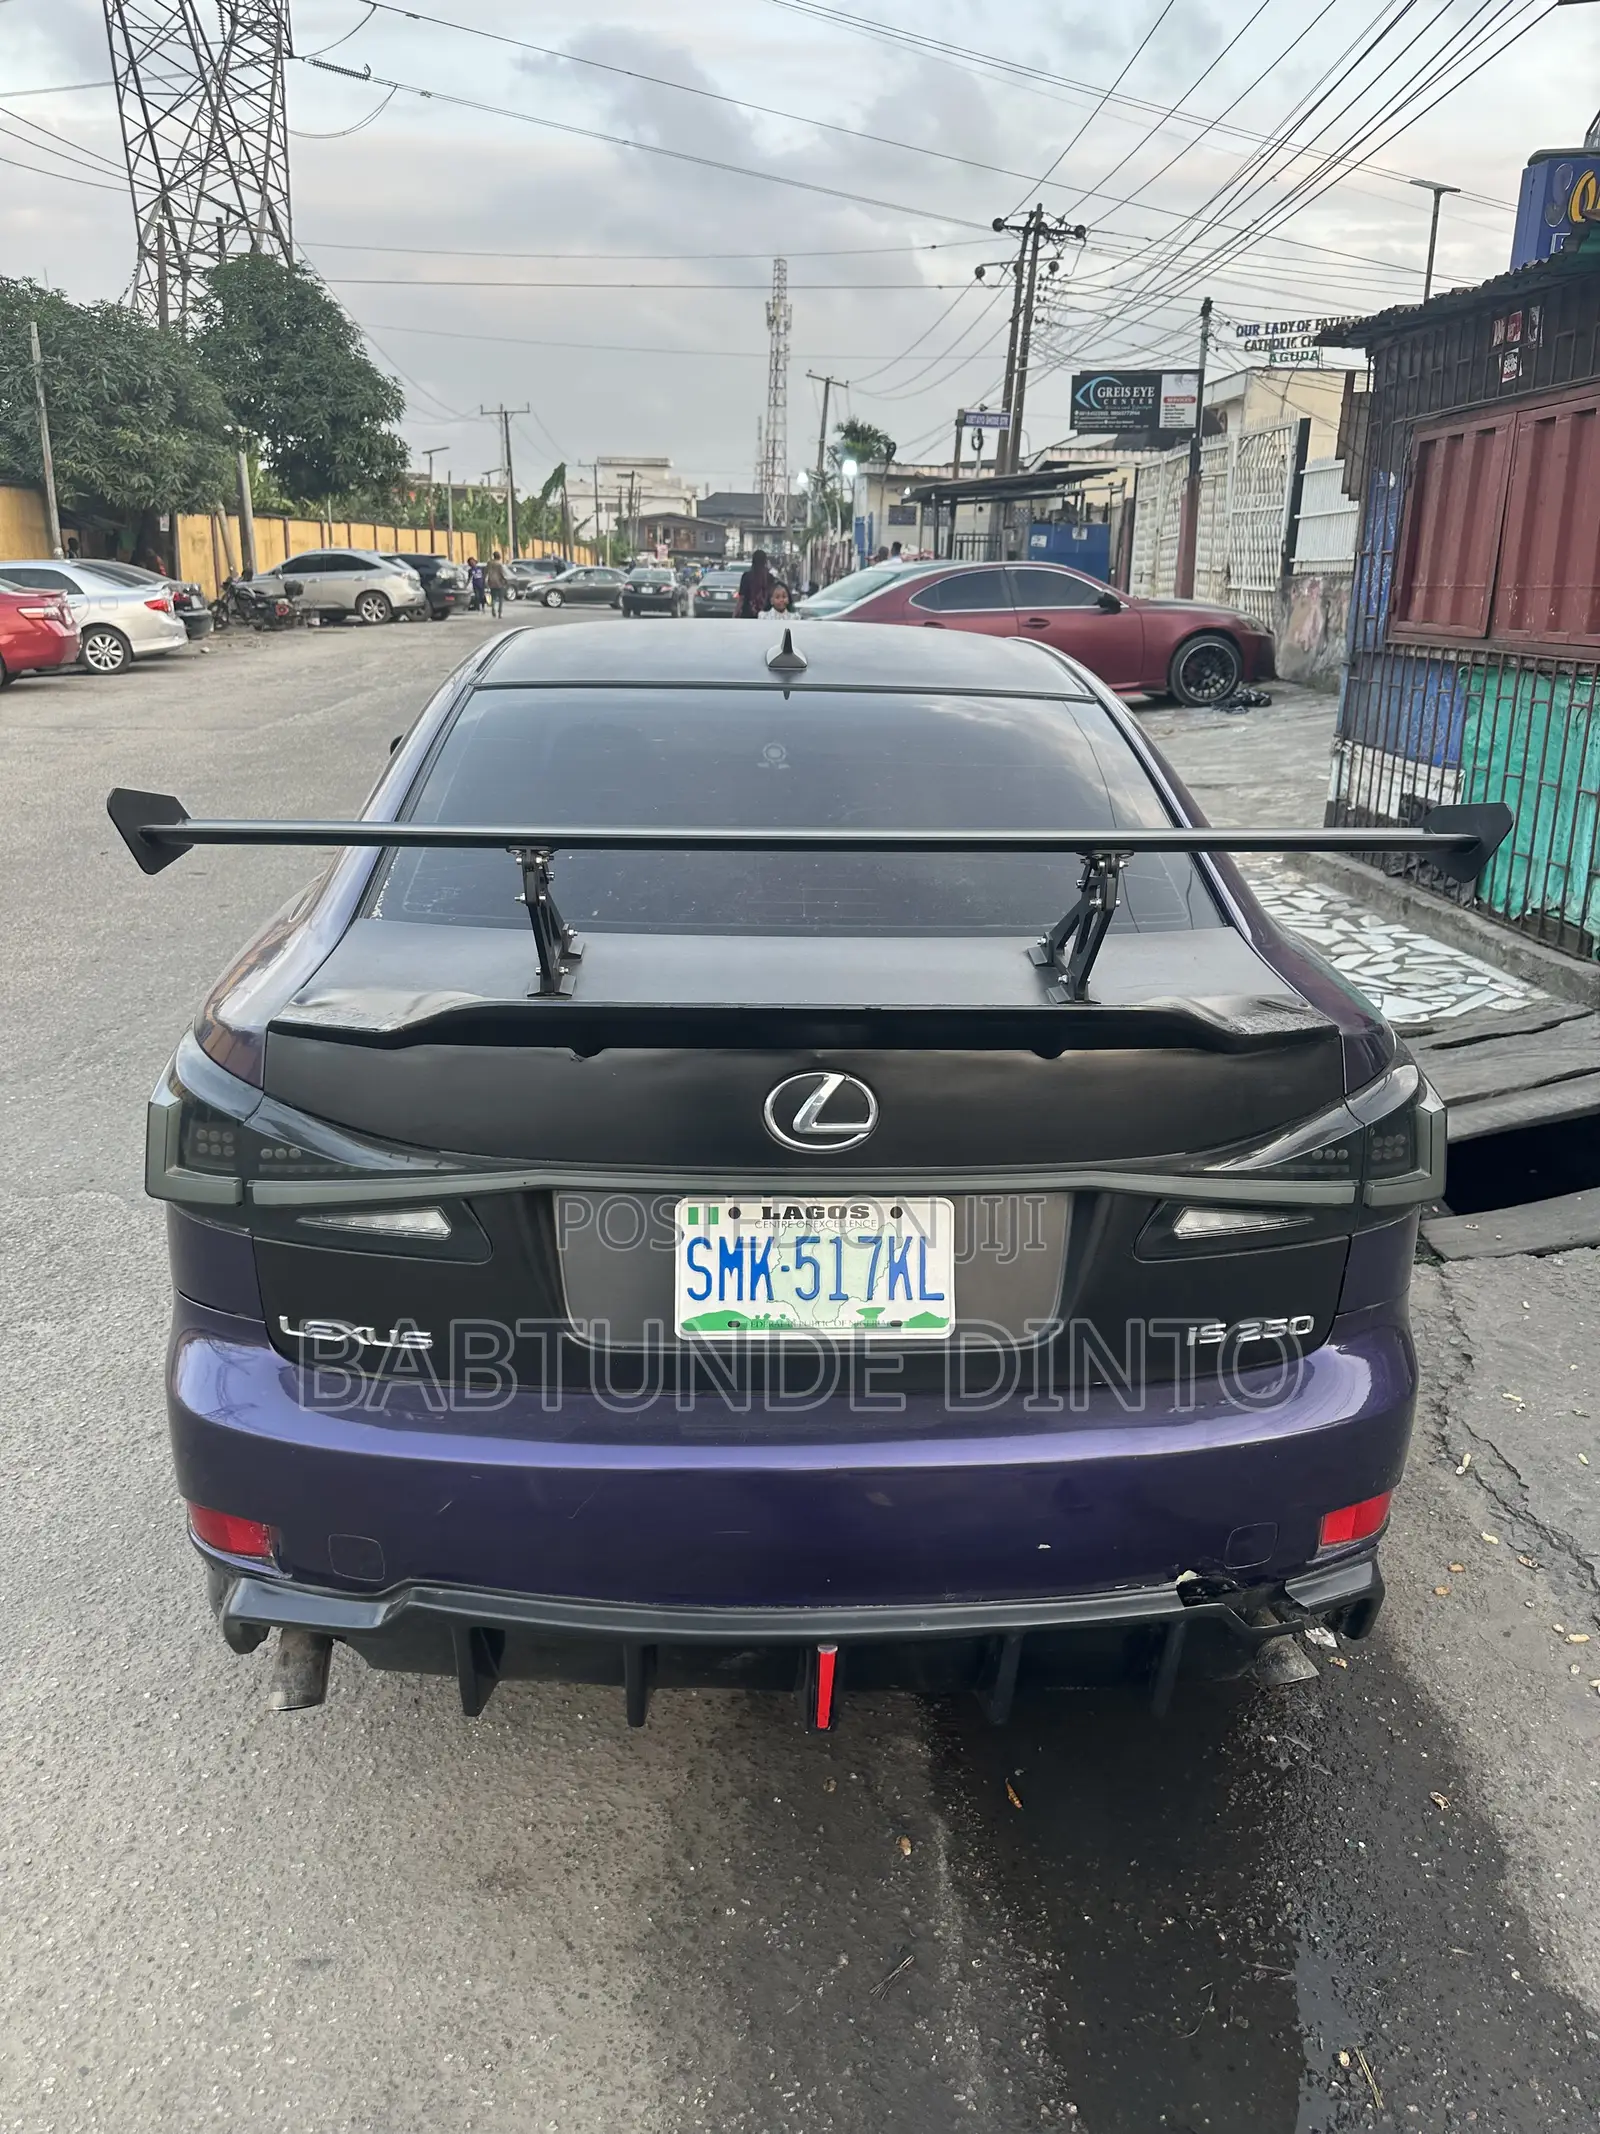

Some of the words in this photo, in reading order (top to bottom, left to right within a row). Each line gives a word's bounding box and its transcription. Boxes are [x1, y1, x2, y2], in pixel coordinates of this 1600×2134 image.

[1236, 324, 1260, 337] OUR
[1265, 321, 1296, 335] LADY
[1297, 319, 1312, 332] OF
[1244, 338, 1298, 352] CATHOLIC
[1269, 350, 1319, 362] AGUDA
[1097, 386, 1131, 398] GREIS
[1133, 386, 1155, 397] EYE
[761, 1205, 870, 1220] LAGOS
[754, 1220, 794, 1229] CENTRE
[796, 1220, 812, 1229] OF
[813, 1220, 877, 1229] EXCELLENCE
[686, 1235, 945, 1302] SMK-517KL
[279, 1315, 433, 1350] LEXUS
[1186, 1322, 1228, 1346] IS
[1235, 1315, 1315, 1343] 250
